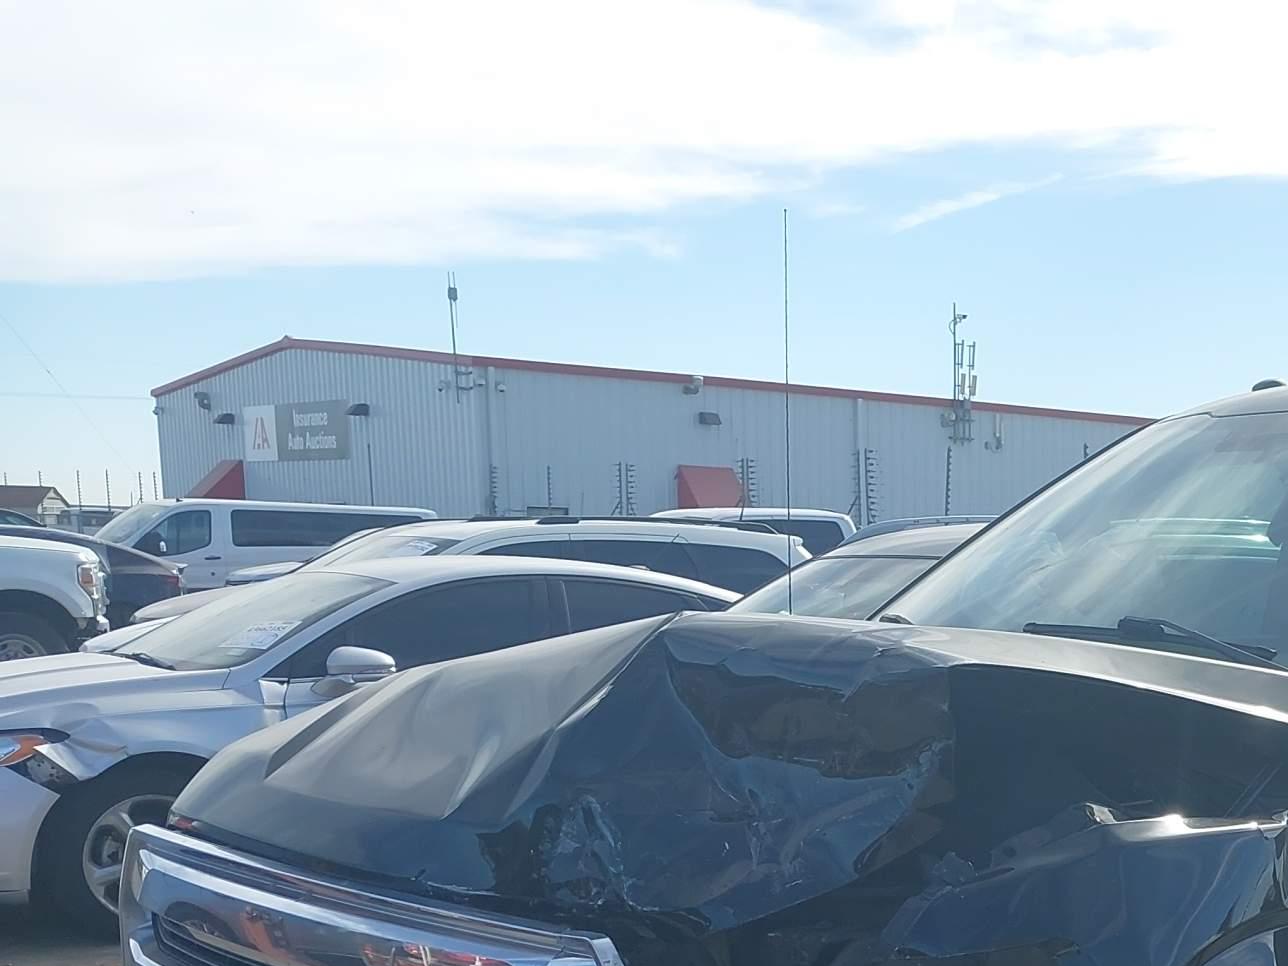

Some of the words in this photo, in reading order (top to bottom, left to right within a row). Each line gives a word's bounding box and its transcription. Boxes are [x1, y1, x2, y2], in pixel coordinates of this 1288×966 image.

[292, 408, 328, 427] Insurance
[288, 432, 305, 450] Auto
[305, 430, 337, 449] Auctions
